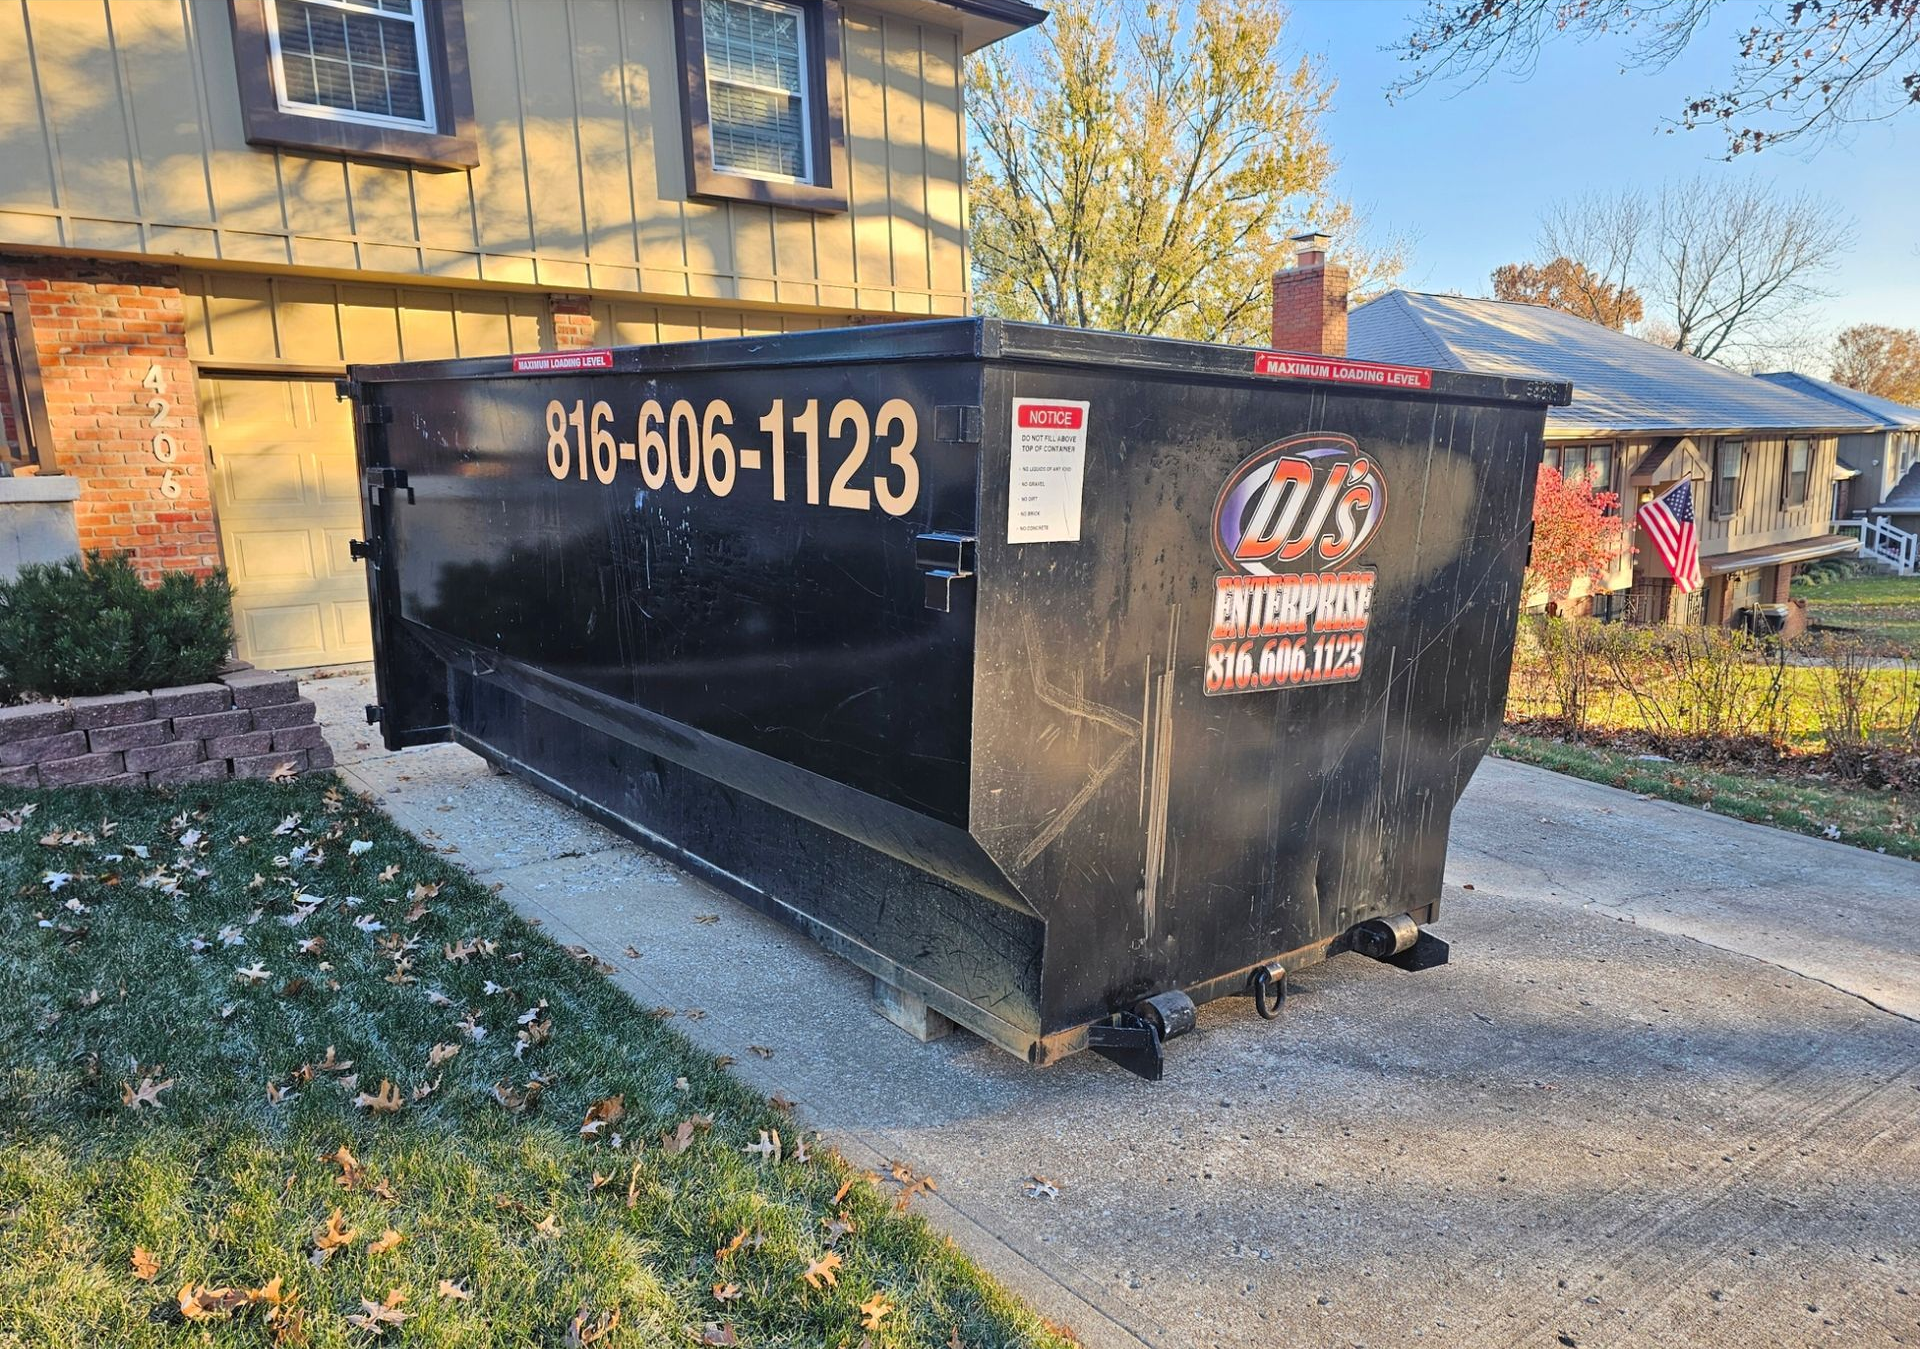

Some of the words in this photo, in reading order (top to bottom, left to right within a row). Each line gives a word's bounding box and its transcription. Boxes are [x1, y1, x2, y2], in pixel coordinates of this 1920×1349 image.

[518, 361, 549, 370] MAXIMUM
[550, 358, 581, 368] LOADING
[583, 356, 606, 366] LEVEL
[1267, 361, 1329, 377] MAXIMUM
[1333, 368, 1384, 382] LOADING
[1387, 373, 1421, 386] LEVEL
[1030, 411, 1072, 425] NOTICE
[545, 398, 921, 517] 816-606-1123
[1212, 573, 1375, 639] ENTERPRISE
[1206, 633, 1364, 691] 816.606.1123
